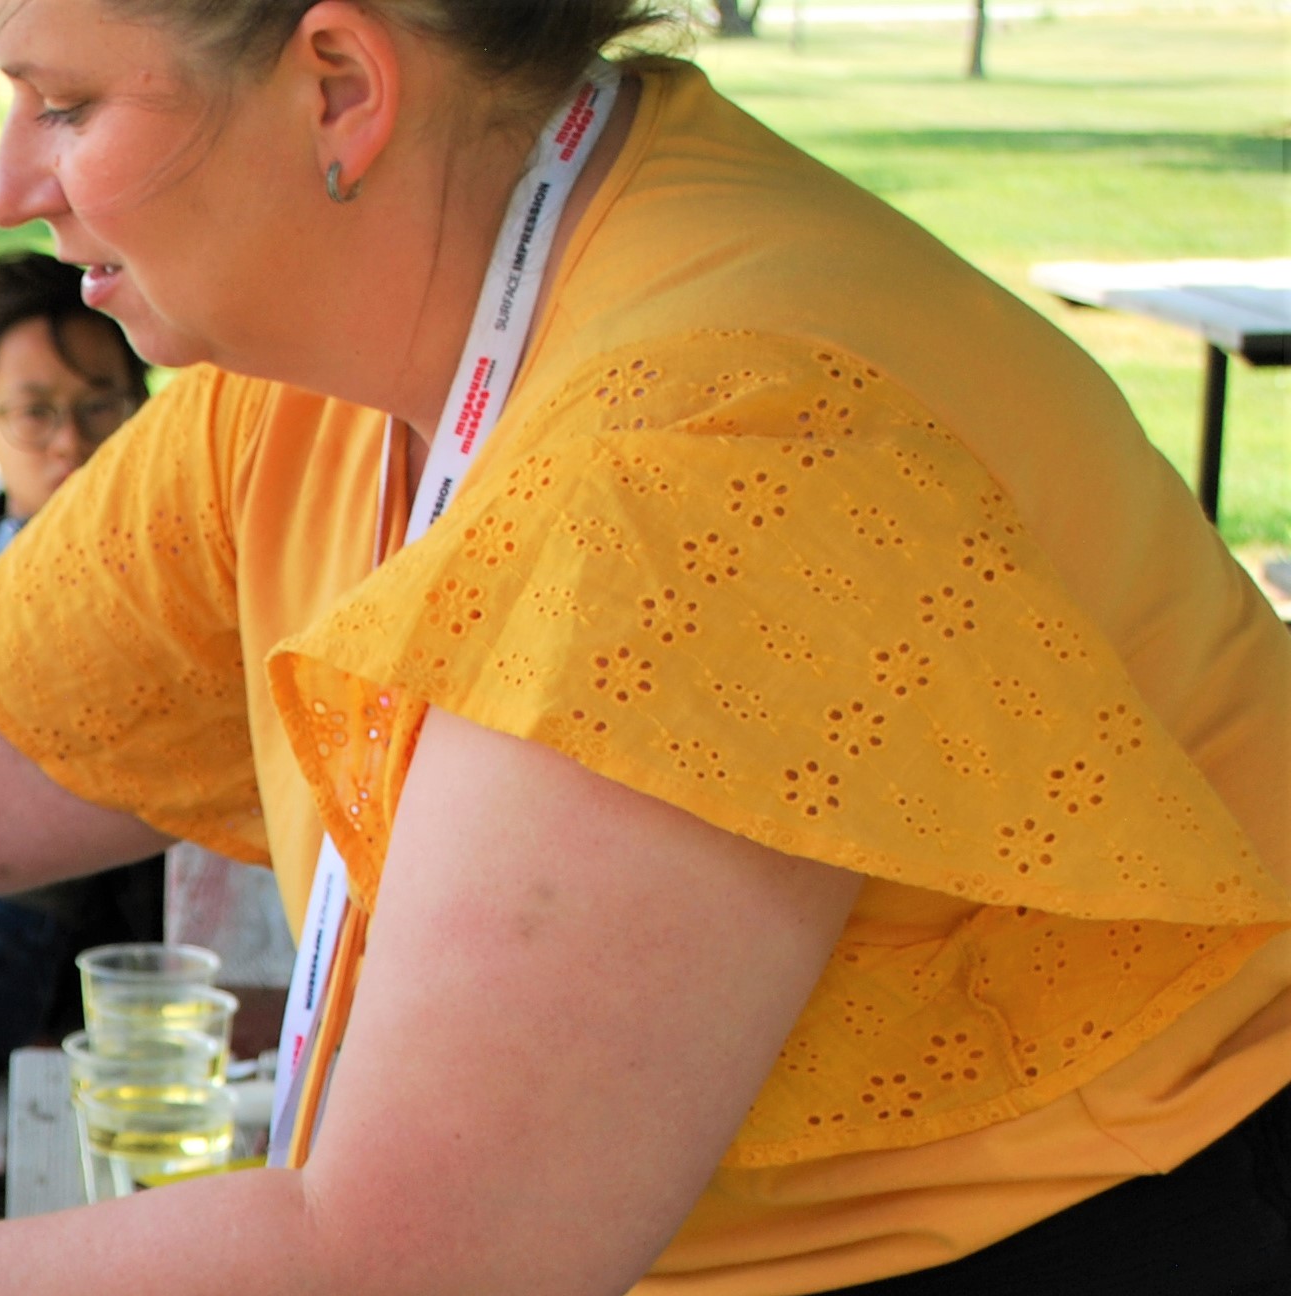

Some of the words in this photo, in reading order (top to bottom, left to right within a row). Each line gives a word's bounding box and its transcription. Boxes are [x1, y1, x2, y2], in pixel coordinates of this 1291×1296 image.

[494, 271, 519, 331] SURFACE
[512, 182, 550, 271] IMPRESSION
[455, 356, 488, 435] museums
